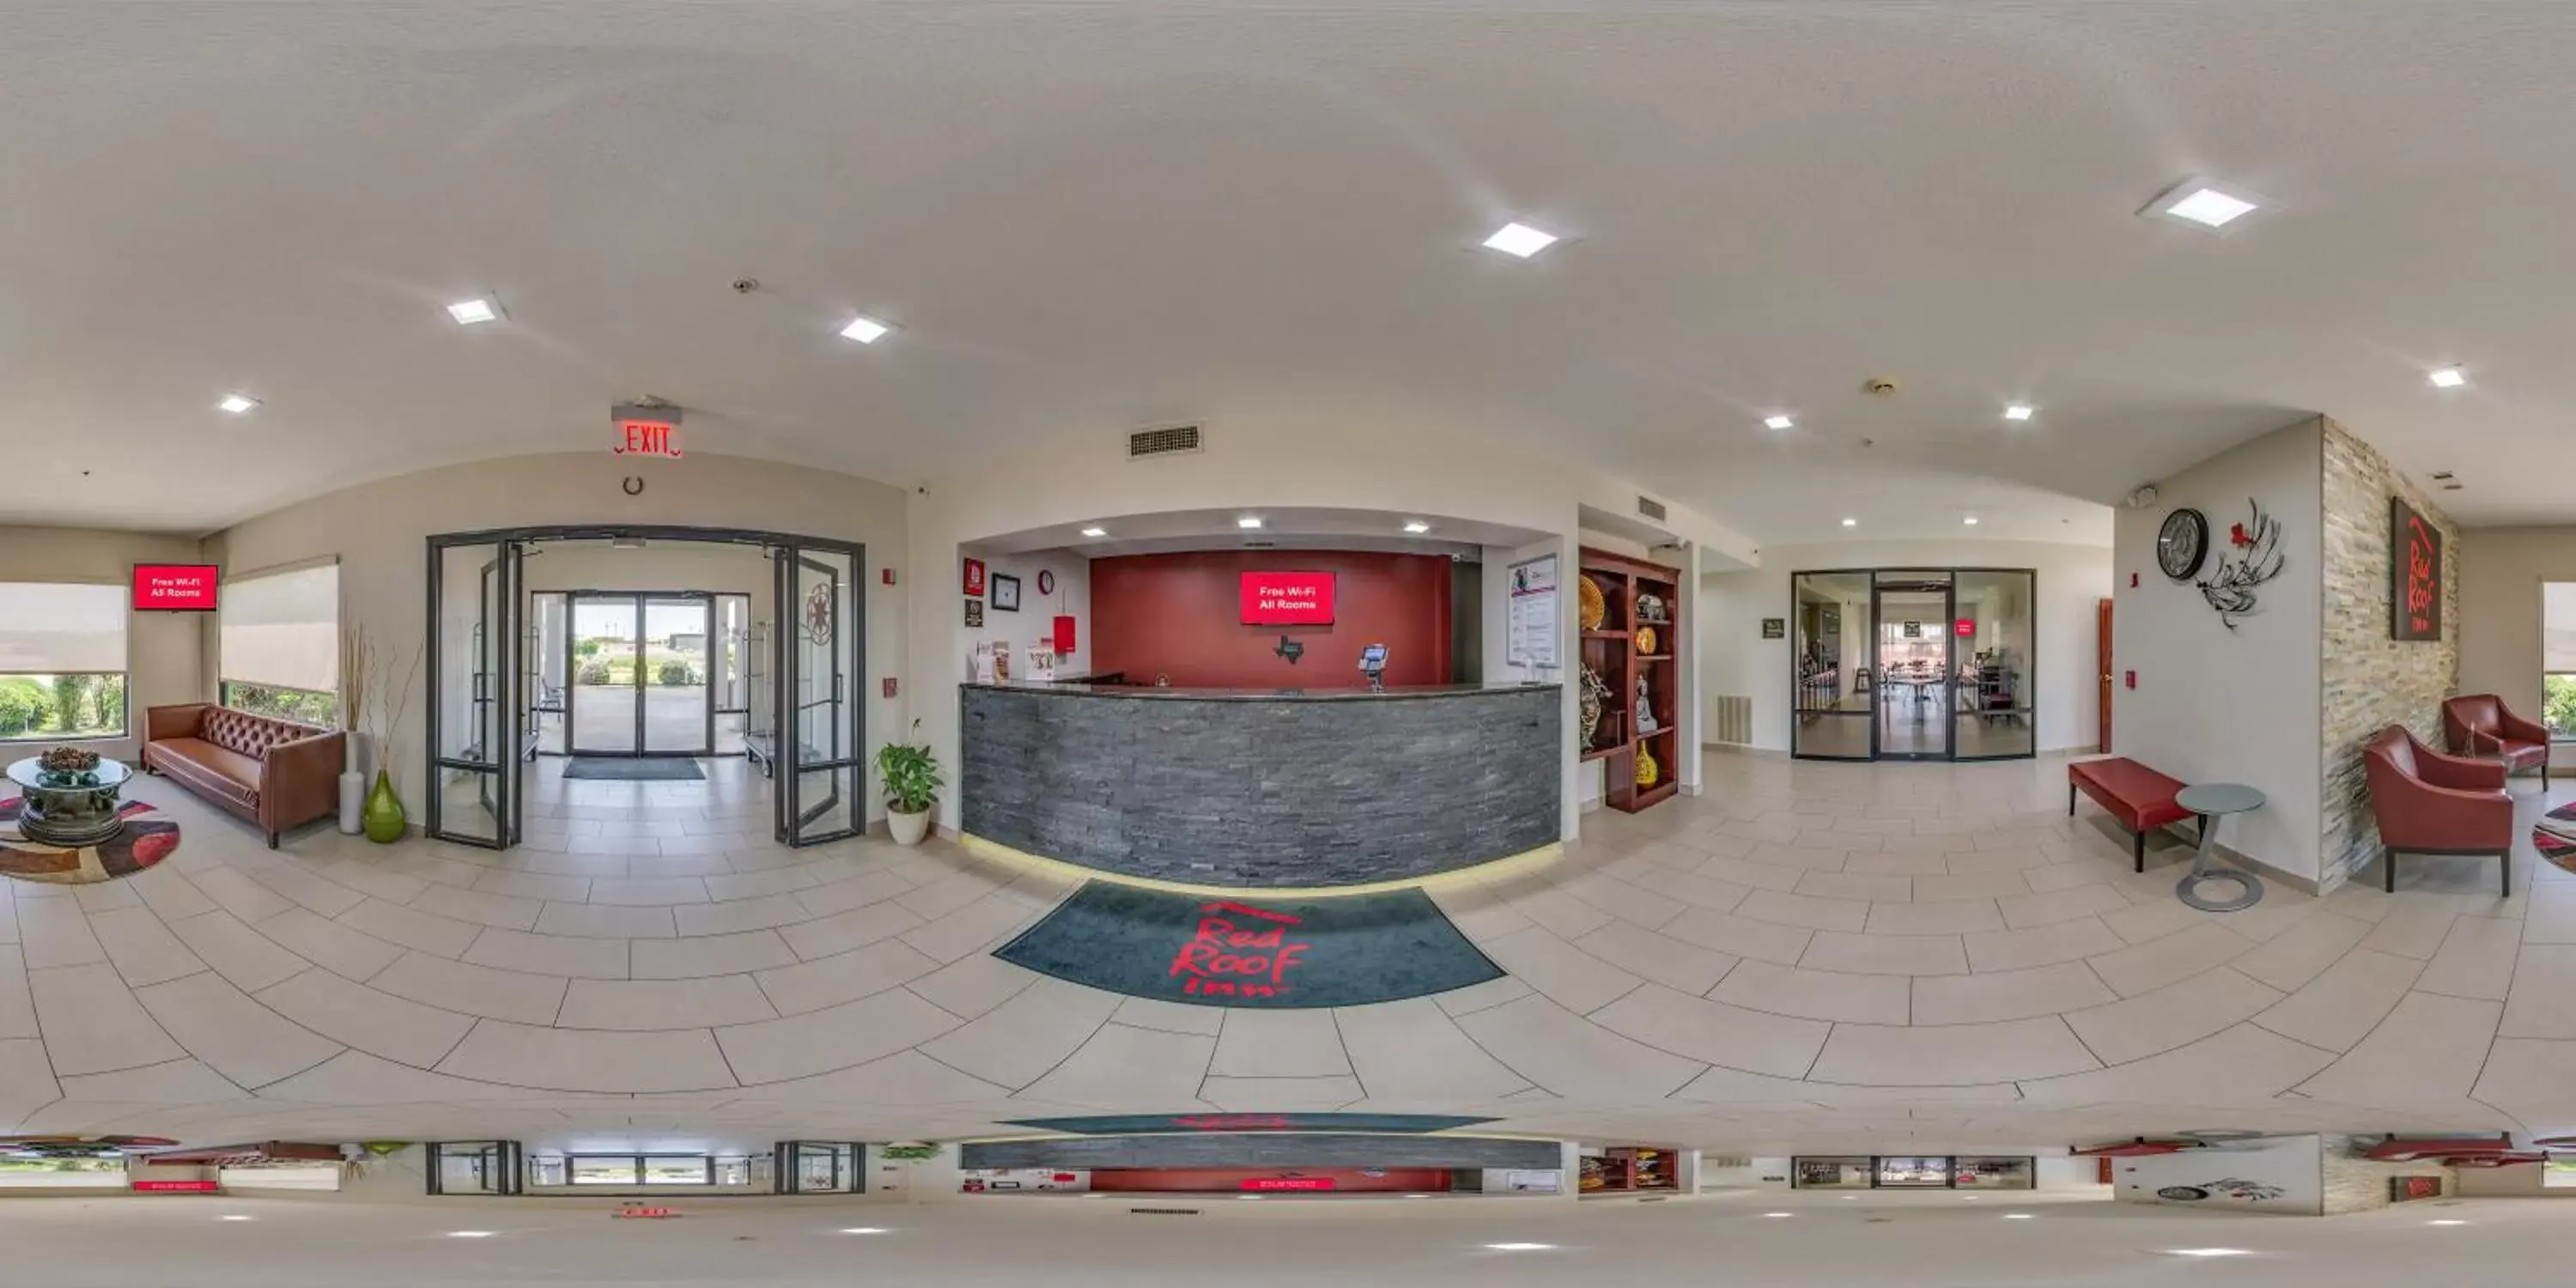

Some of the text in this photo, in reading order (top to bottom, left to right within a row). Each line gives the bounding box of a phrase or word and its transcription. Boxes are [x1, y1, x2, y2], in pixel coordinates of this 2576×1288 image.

[626, 425, 671, 453] EXIT
[2410, 540, 2431, 580] Red
[151, 588, 200, 598] All Rooms
[152, 578, 200, 586] Free Wi-Fi
[1260, 586, 1316, 598] Free Wi-Fi
[2409, 574, 2434, 618] Roof
[1260, 600, 1316, 610] All Rooms
[1194, 916, 1285, 949] Red
[1169, 941, 1311, 985] Roof
